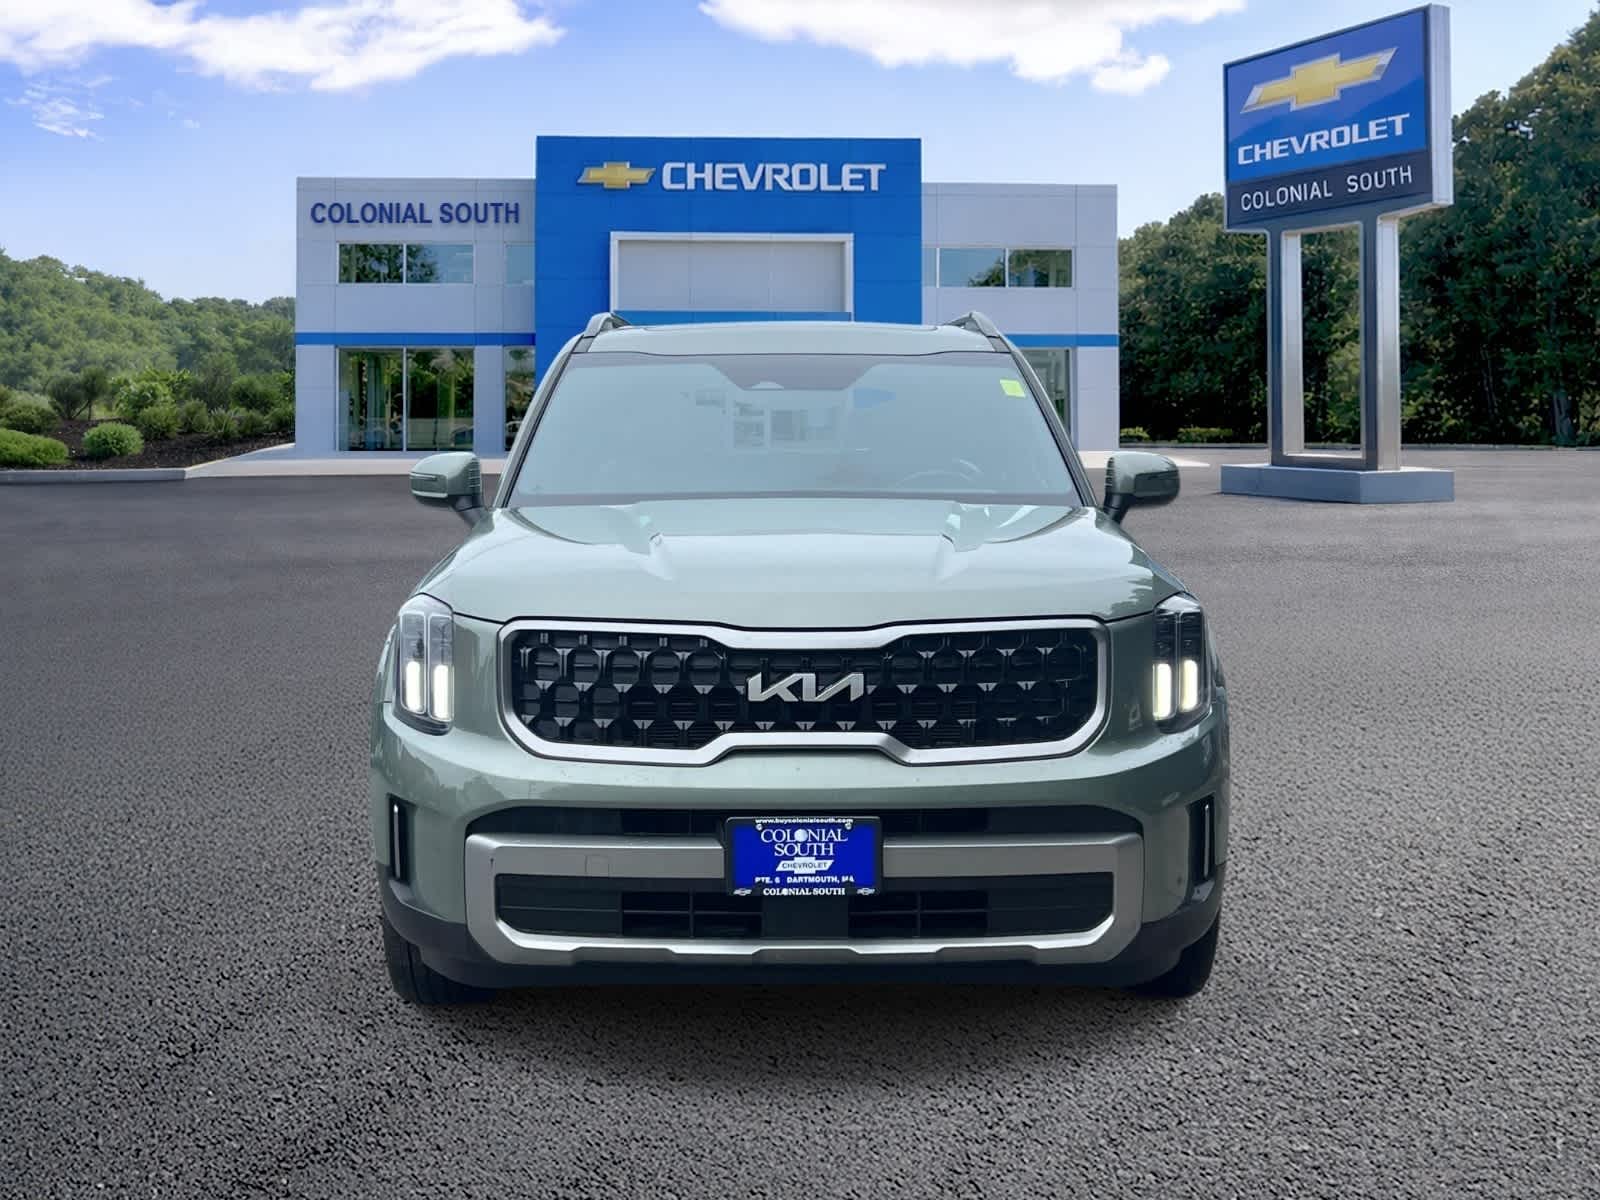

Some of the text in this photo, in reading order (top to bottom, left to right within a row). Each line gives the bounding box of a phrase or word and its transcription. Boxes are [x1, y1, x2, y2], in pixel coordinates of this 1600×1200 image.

[1238, 113, 1410, 165] CHEVROLET
[662, 162, 887, 192] CHEVROLET
[1241, 165, 1413, 211] COLONIAL SOUTH
[310, 202, 520, 224] COLONIAL SOUTH
[760, 828, 848, 843] COLONIAL
[774, 843, 835, 857] SOUTH
[781, 861, 828, 870] CHEVROLET
[763, 887, 846, 896] COLONIAL SOUTH
